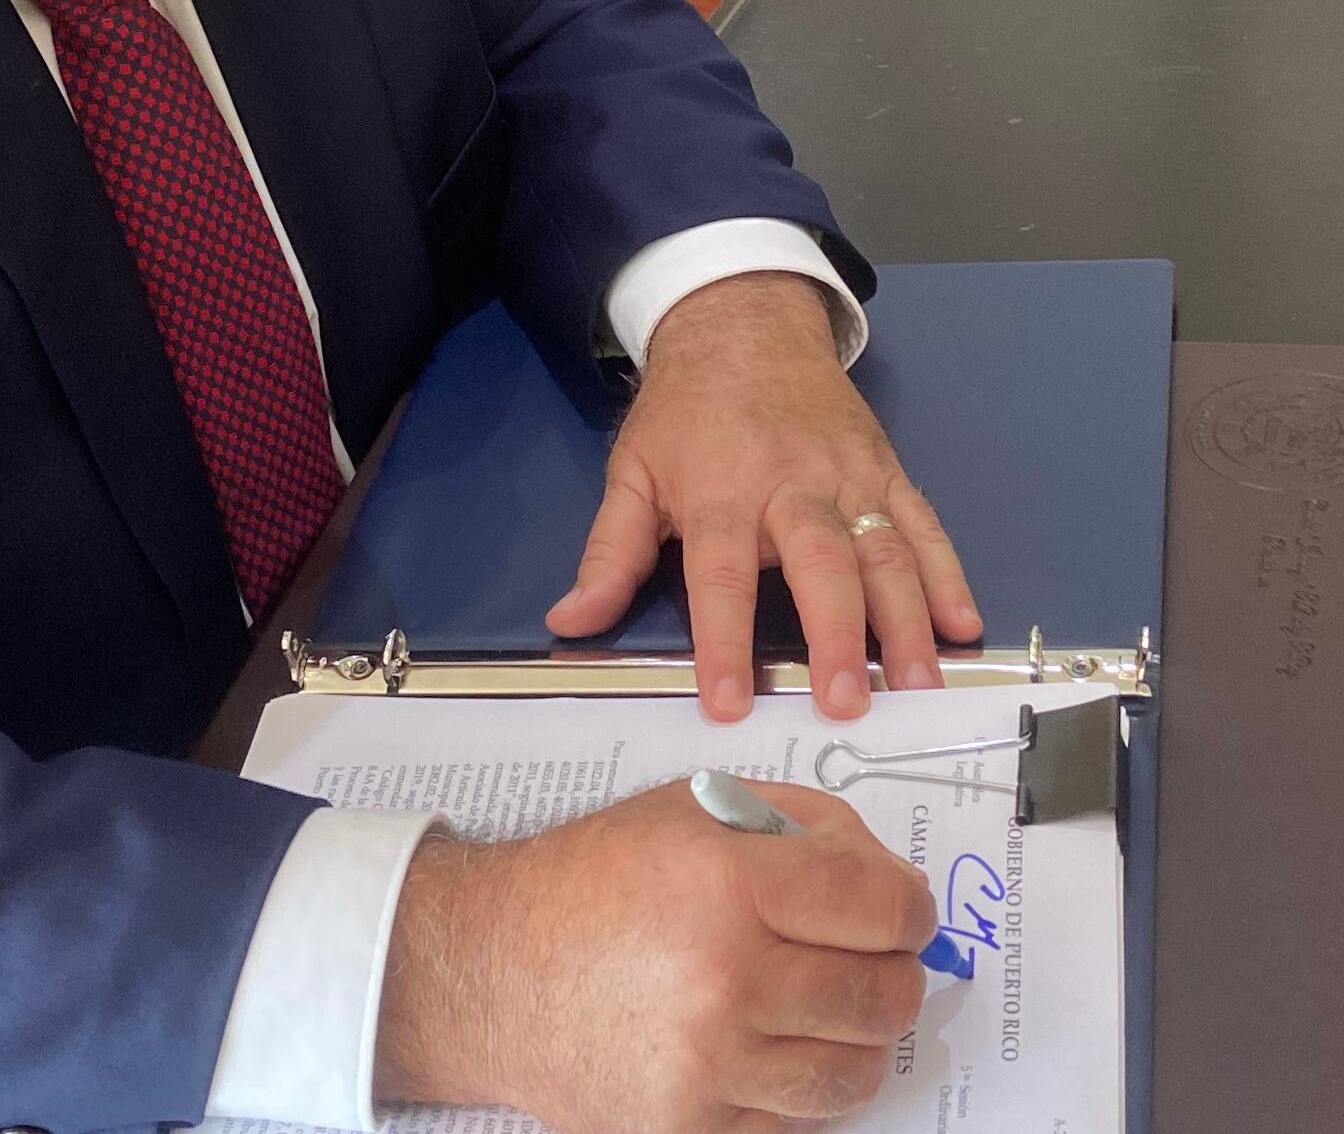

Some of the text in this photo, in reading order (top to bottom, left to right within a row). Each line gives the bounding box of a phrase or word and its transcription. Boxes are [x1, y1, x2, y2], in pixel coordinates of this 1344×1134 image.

[612, 740, 625, 758] Para
[313, 766, 331, 794] Puerto
[343, 766, 362, 798] Proceso
[390, 765, 409, 808] enmendar
[438, 764, 458, 808] Municipal
[910, 805, 932, 865] CÁMAR
[1005, 912, 1022, 937] DE
[1003, 943, 1022, 1014] PUERTO
[1001, 1019, 1020, 1062] RICO
[957, 1085, 972, 1119] Sesión
